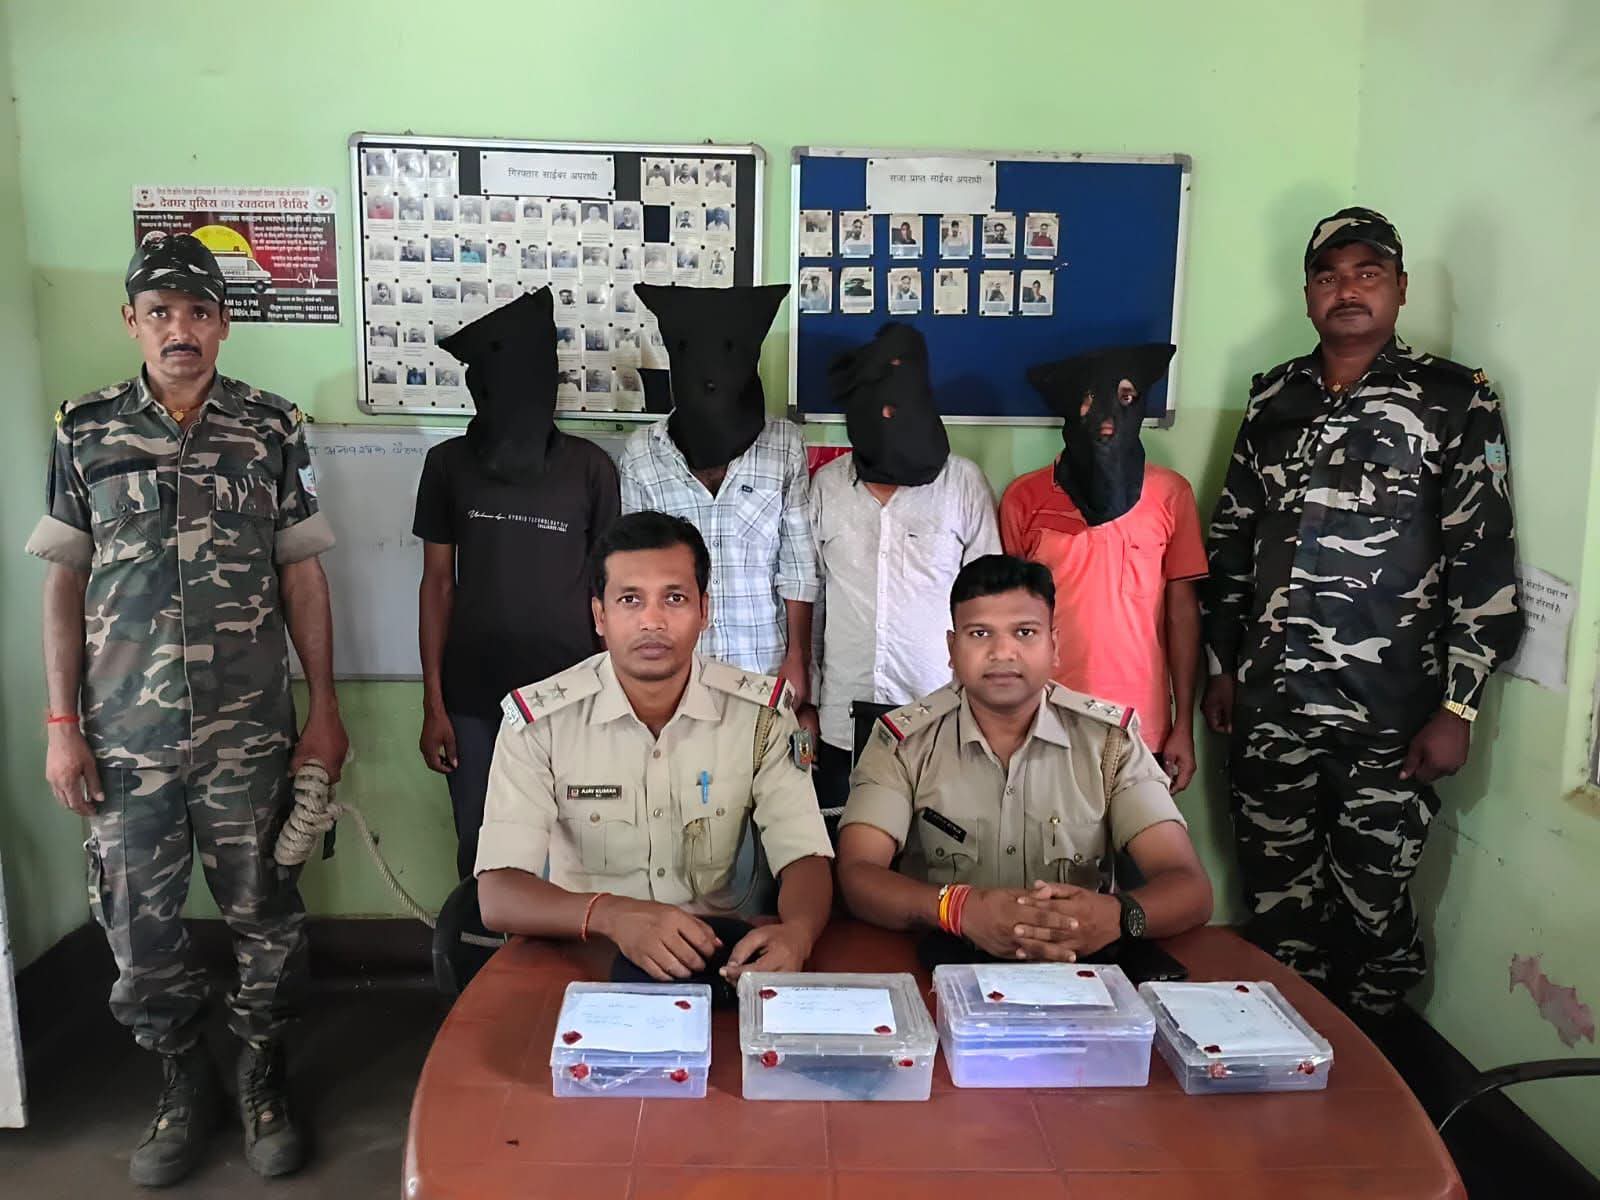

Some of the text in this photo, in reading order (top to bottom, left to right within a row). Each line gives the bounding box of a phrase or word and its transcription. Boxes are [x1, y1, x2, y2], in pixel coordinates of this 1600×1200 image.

[508, 167, 598, 181] गिरफ्तार साईबर अपराधी
[889, 172, 983, 185] सजा प्राप्त साईबर अपराधी
[160, 196, 309, 210] देवघर पुलिस का रक्तदान शिविर
[248, 299, 259, 307] PM
